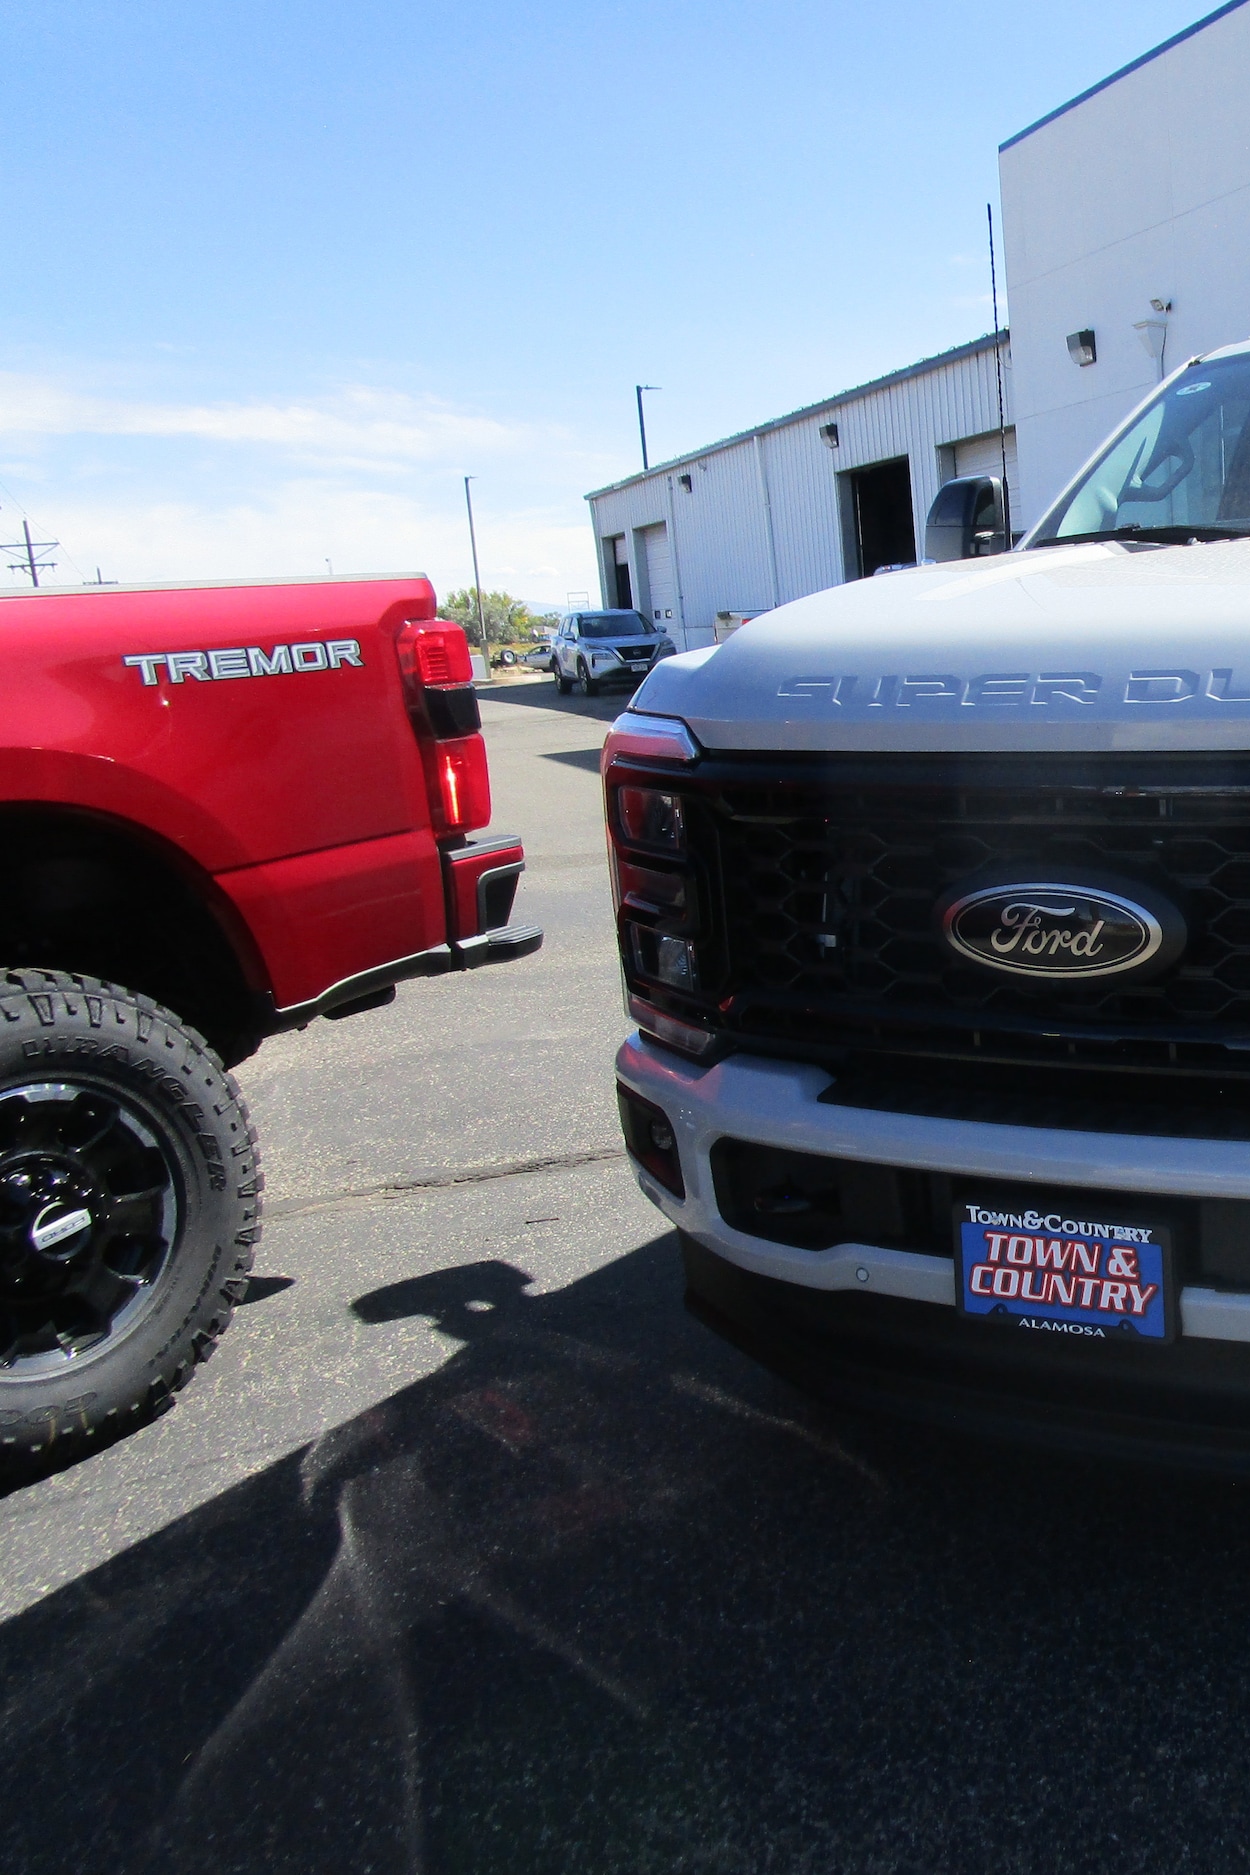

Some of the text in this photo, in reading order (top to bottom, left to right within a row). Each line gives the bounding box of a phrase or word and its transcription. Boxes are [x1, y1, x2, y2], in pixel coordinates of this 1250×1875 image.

[122, 638, 365, 686] TREMOR
[777, 672, 1102, 706] SUPER
[990, 902, 1104, 957] Ford
[984, 1230, 1141, 1279] TOWN &
[970, 1263, 1158, 1316] COUNTRY
[1018, 1317, 1106, 1339] ALAMOSA
